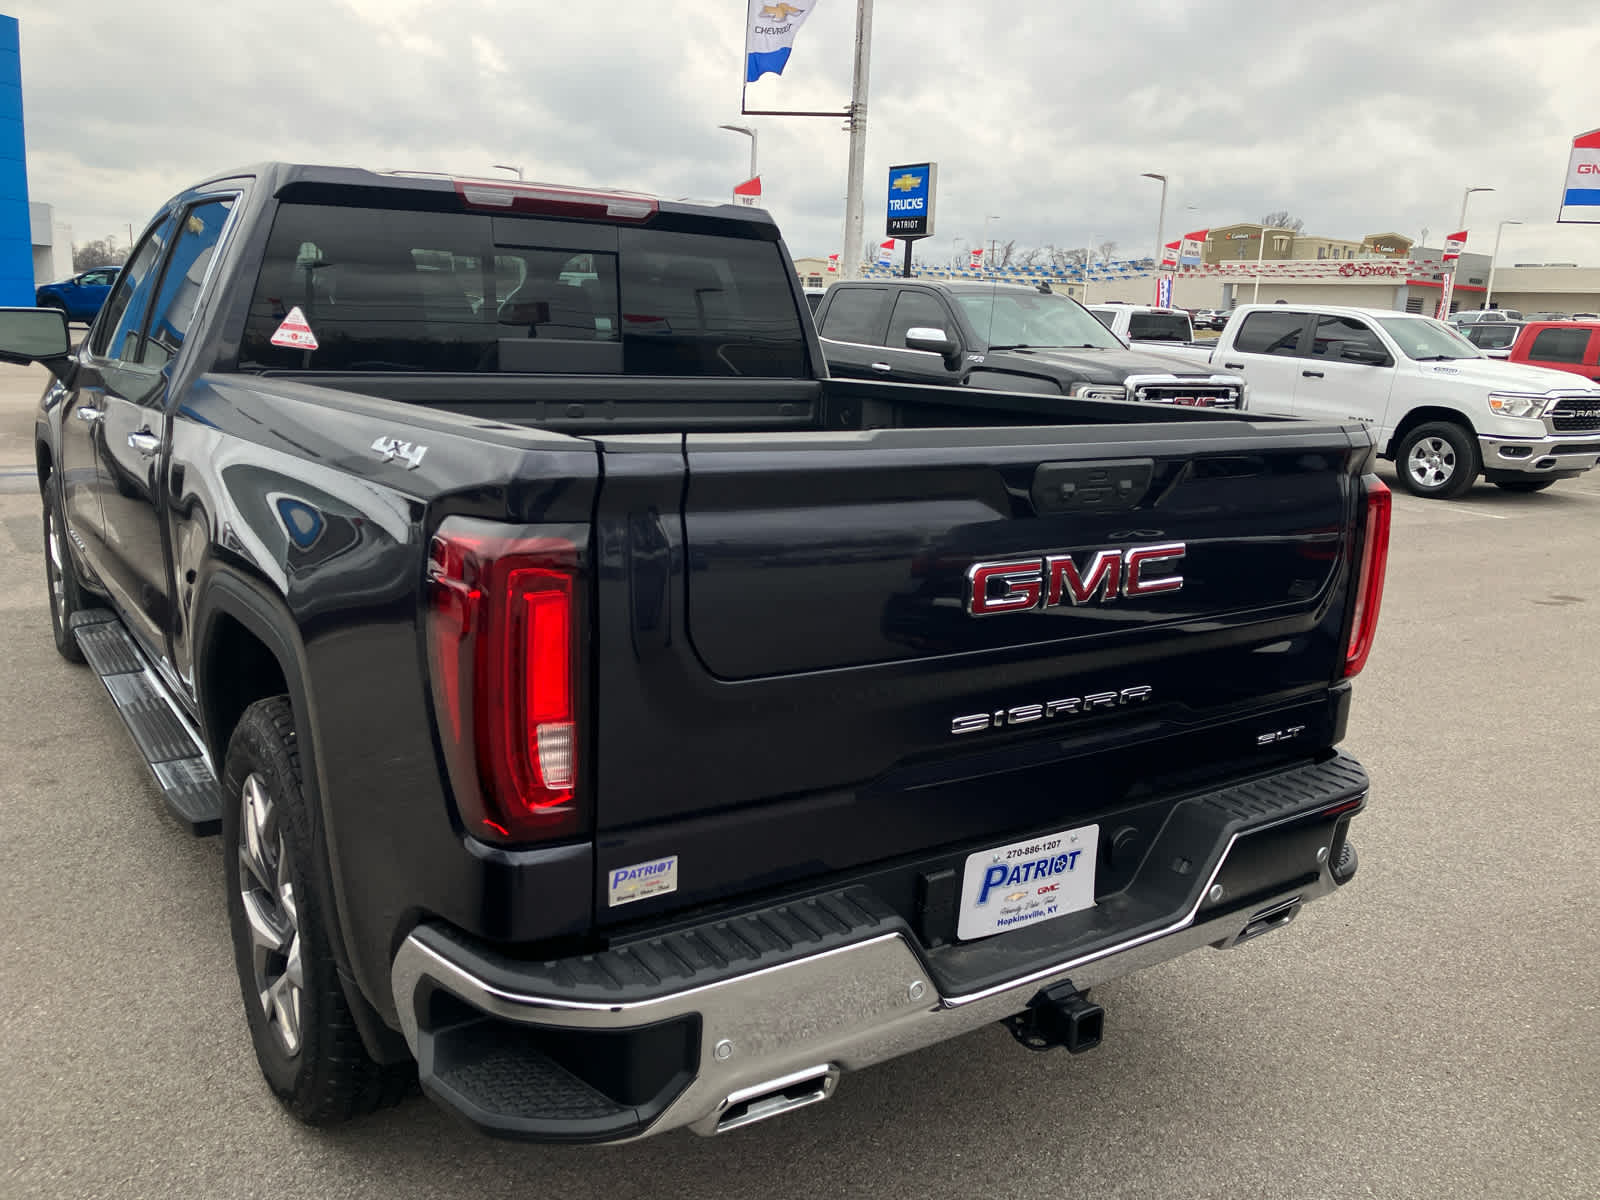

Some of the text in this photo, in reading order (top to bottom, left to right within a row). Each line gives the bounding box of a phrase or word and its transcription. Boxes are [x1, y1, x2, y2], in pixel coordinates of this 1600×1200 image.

[889, 197, 924, 211] TRUCKS
[892, 220, 918, 229] PATRIOT
[967, 542, 1186, 616] GMC
[951, 685, 1153, 735] SIERRA
[1256, 725, 1306, 746] SLT
[1006, 839, 1062, 860] 270-886-1207
[613, 861, 674, 889] PATRIOT
[977, 852, 1080, 906] PATRIOT
[1047, 904, 1059, 914] KY
